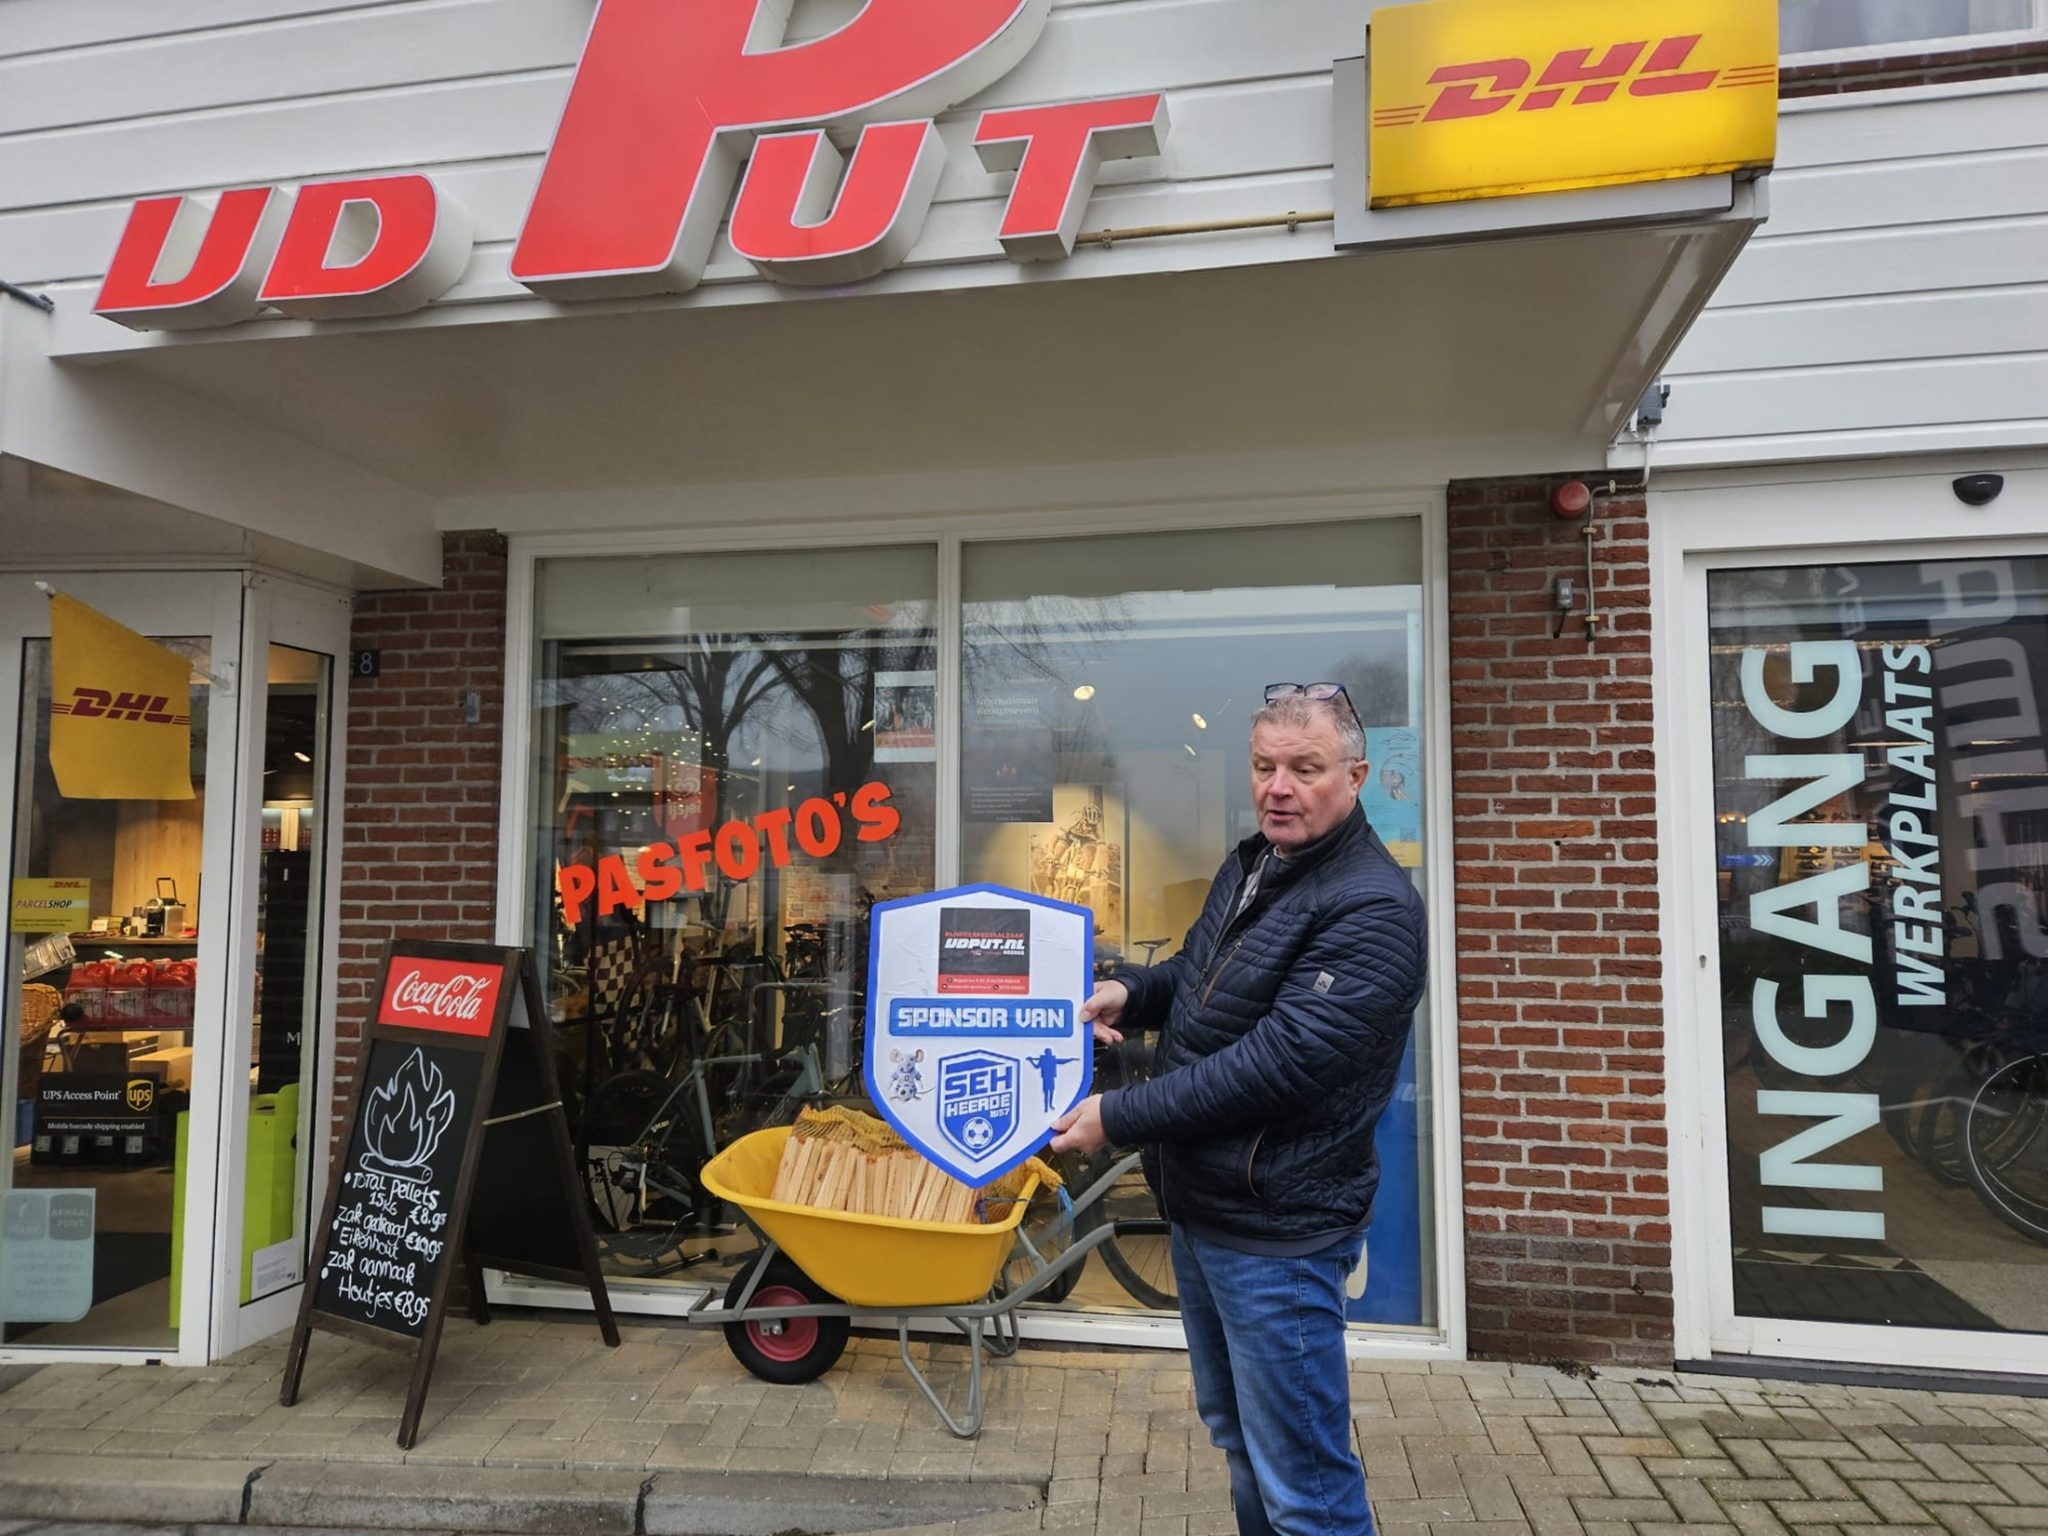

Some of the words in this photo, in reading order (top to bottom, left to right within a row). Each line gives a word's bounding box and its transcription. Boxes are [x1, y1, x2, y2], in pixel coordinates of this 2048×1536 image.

[1421, 33, 1722, 124] DHL
[360, 652, 372, 674] 8
[70, 686, 175, 724] DHL
[1881, 640, 1947, 1007] WERKPLAATS
[557, 781, 900, 928] PASFOTO'S
[53, 881, 82, 889] DHL
[15, 900, 73, 909] PARCELSHOP
[1739, 638, 1887, 1241] INGANG
[391, 970, 493, 1020] Coca-Cola
[898, 1007, 1008, 1029] SPONSOR
[1015, 1008, 1065, 1029] VAN
[43, 1090, 62, 1100] UPS
[62, 1091, 93, 1101] Access
[93, 1090, 120, 1101] Point
[944, 1065, 1013, 1101] SEH
[129, 1089, 151, 1107] ups
[946, 1093, 1011, 1118] HEERDE
[47, 1122, 69, 1130] Mobile
[69, 1122, 93, 1130] barcode
[94, 1122, 120, 1132] shipping
[120, 1122, 146, 1130] enabled
